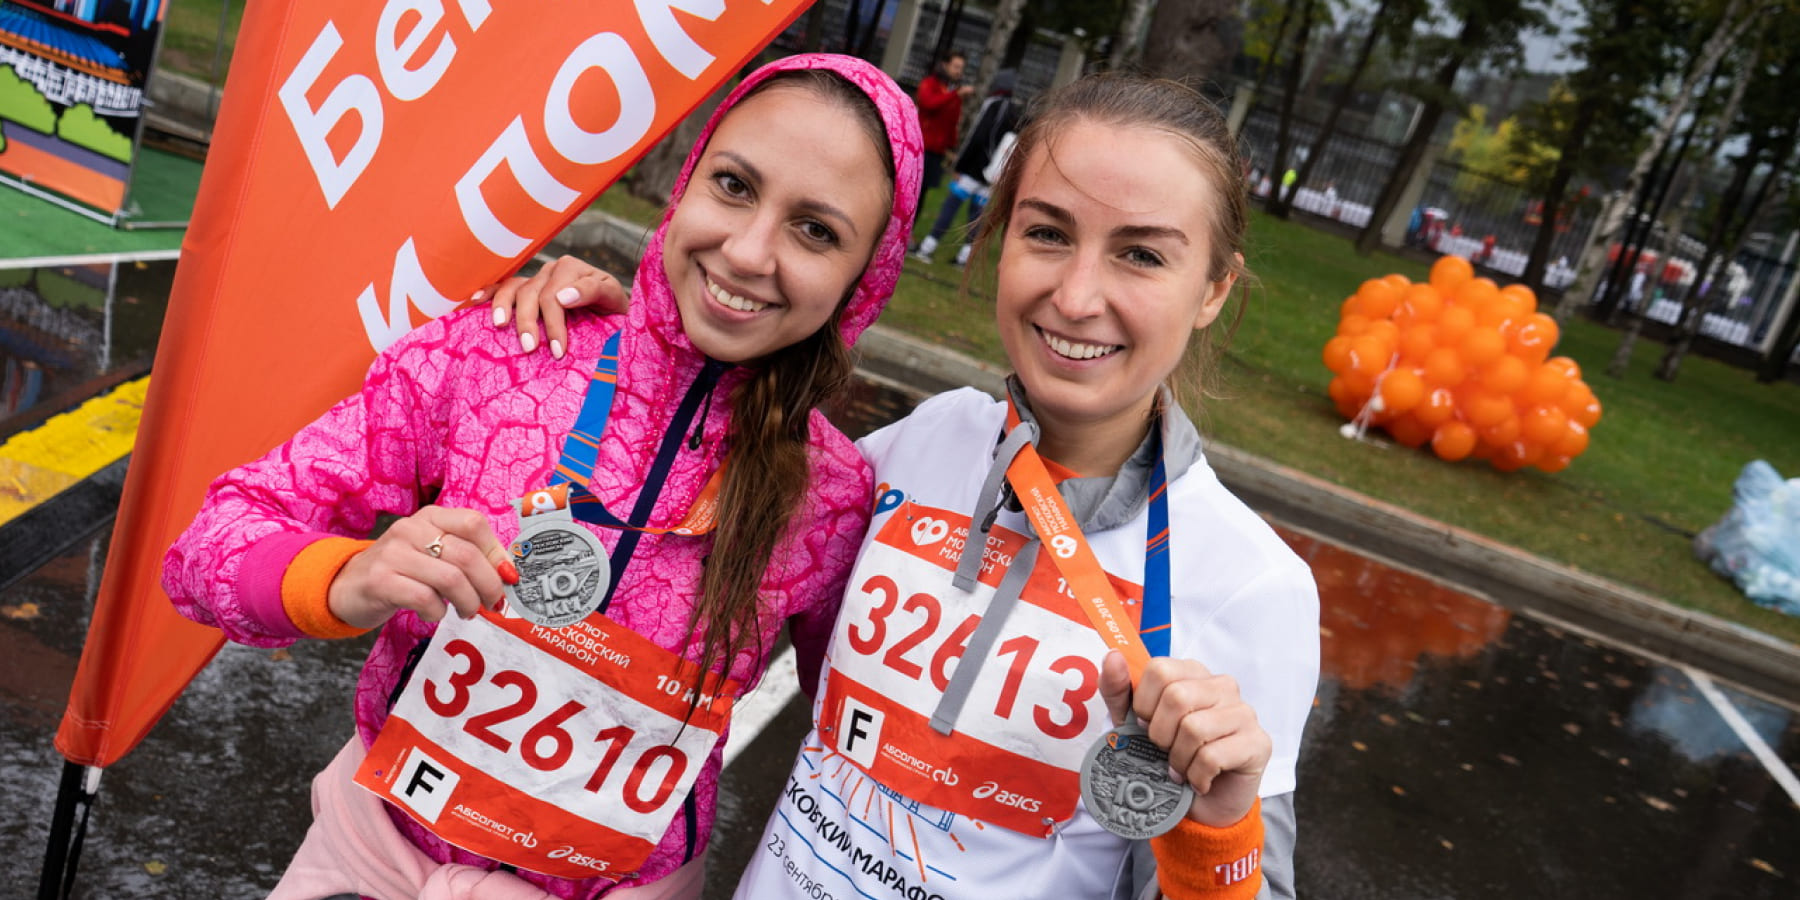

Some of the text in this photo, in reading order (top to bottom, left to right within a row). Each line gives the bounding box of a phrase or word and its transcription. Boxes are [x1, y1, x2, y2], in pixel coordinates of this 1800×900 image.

[537, 570, 578, 601] 10
[530, 624, 598, 666] МАРАФОН
[848, 575, 1100, 740] 32613
[656, 675, 681, 695] 10
[423, 639, 688, 814] 32610
[846, 708, 873, 752] F
[882, 743, 933, 773] АБСОЛЮТ
[404, 760, 445, 798] F
[1113, 774, 1155, 811] 10
[454, 804, 515, 835] АБСОЛЮТ
[767, 833, 786, 858] 23
[1215, 847, 1258, 885] JBL
